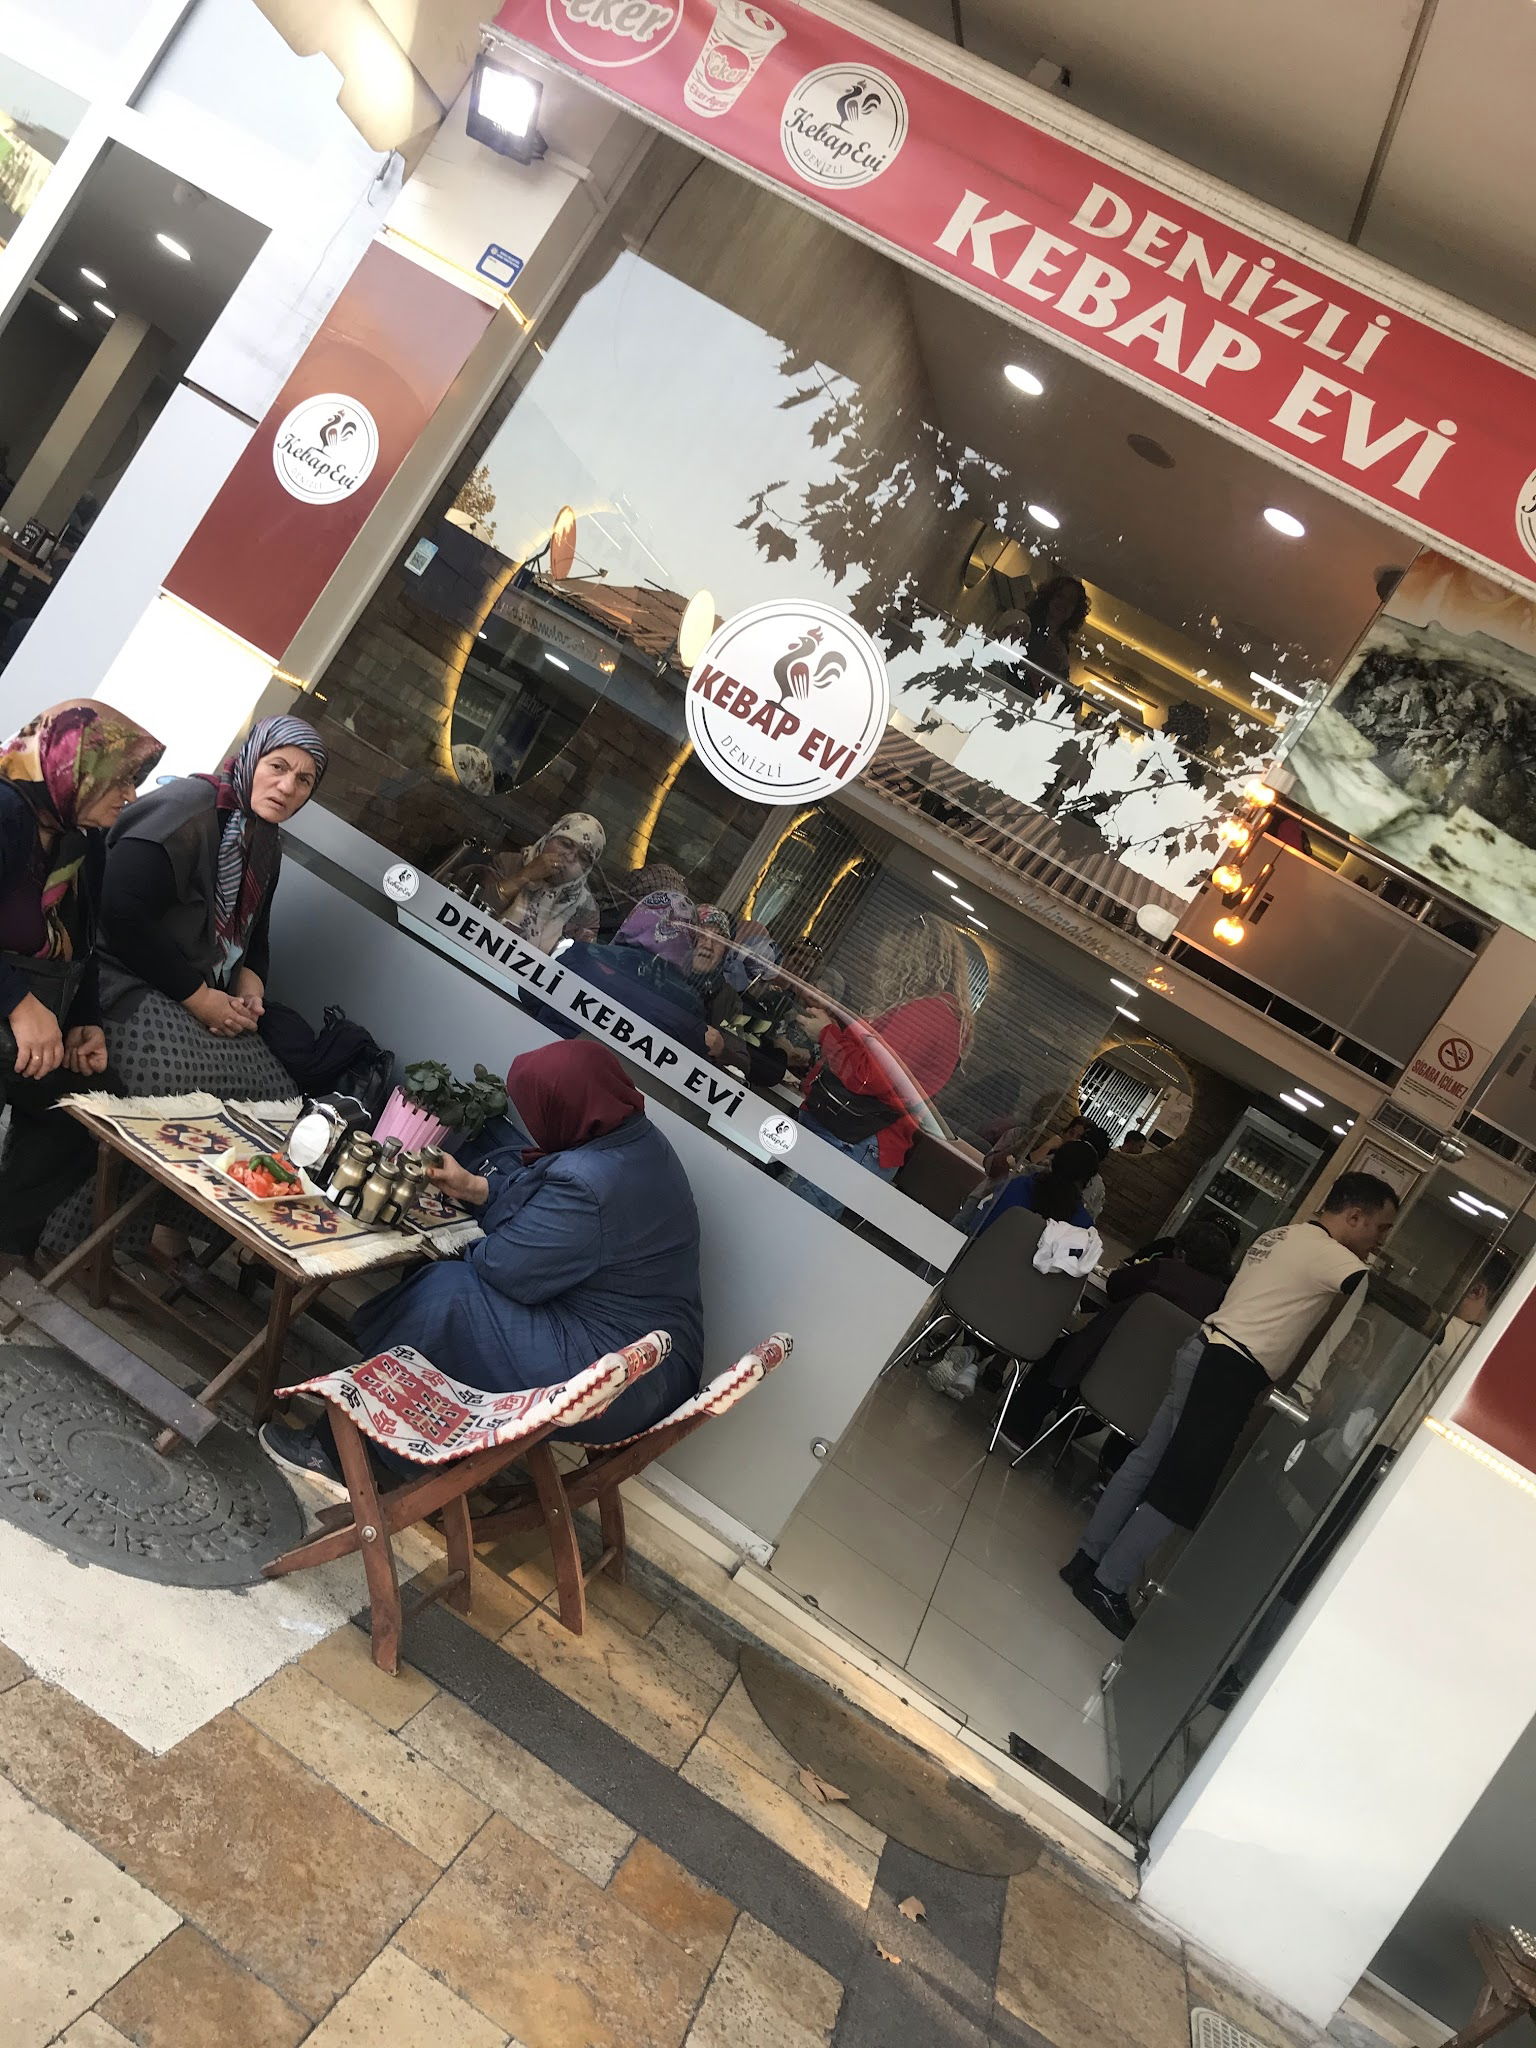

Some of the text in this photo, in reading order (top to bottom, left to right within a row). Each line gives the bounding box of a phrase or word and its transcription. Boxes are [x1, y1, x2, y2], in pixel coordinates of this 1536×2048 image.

[933, 188, 1458, 500] KEBAP EVİ
[1069, 182, 1391, 375] DENİZLİ
[692, 664, 862, 780] KEBAP EVİ
[721, 735, 782, 778] DENİZLİ
[435, 901, 746, 1118] DENİZLİ KEBAP EVİ
